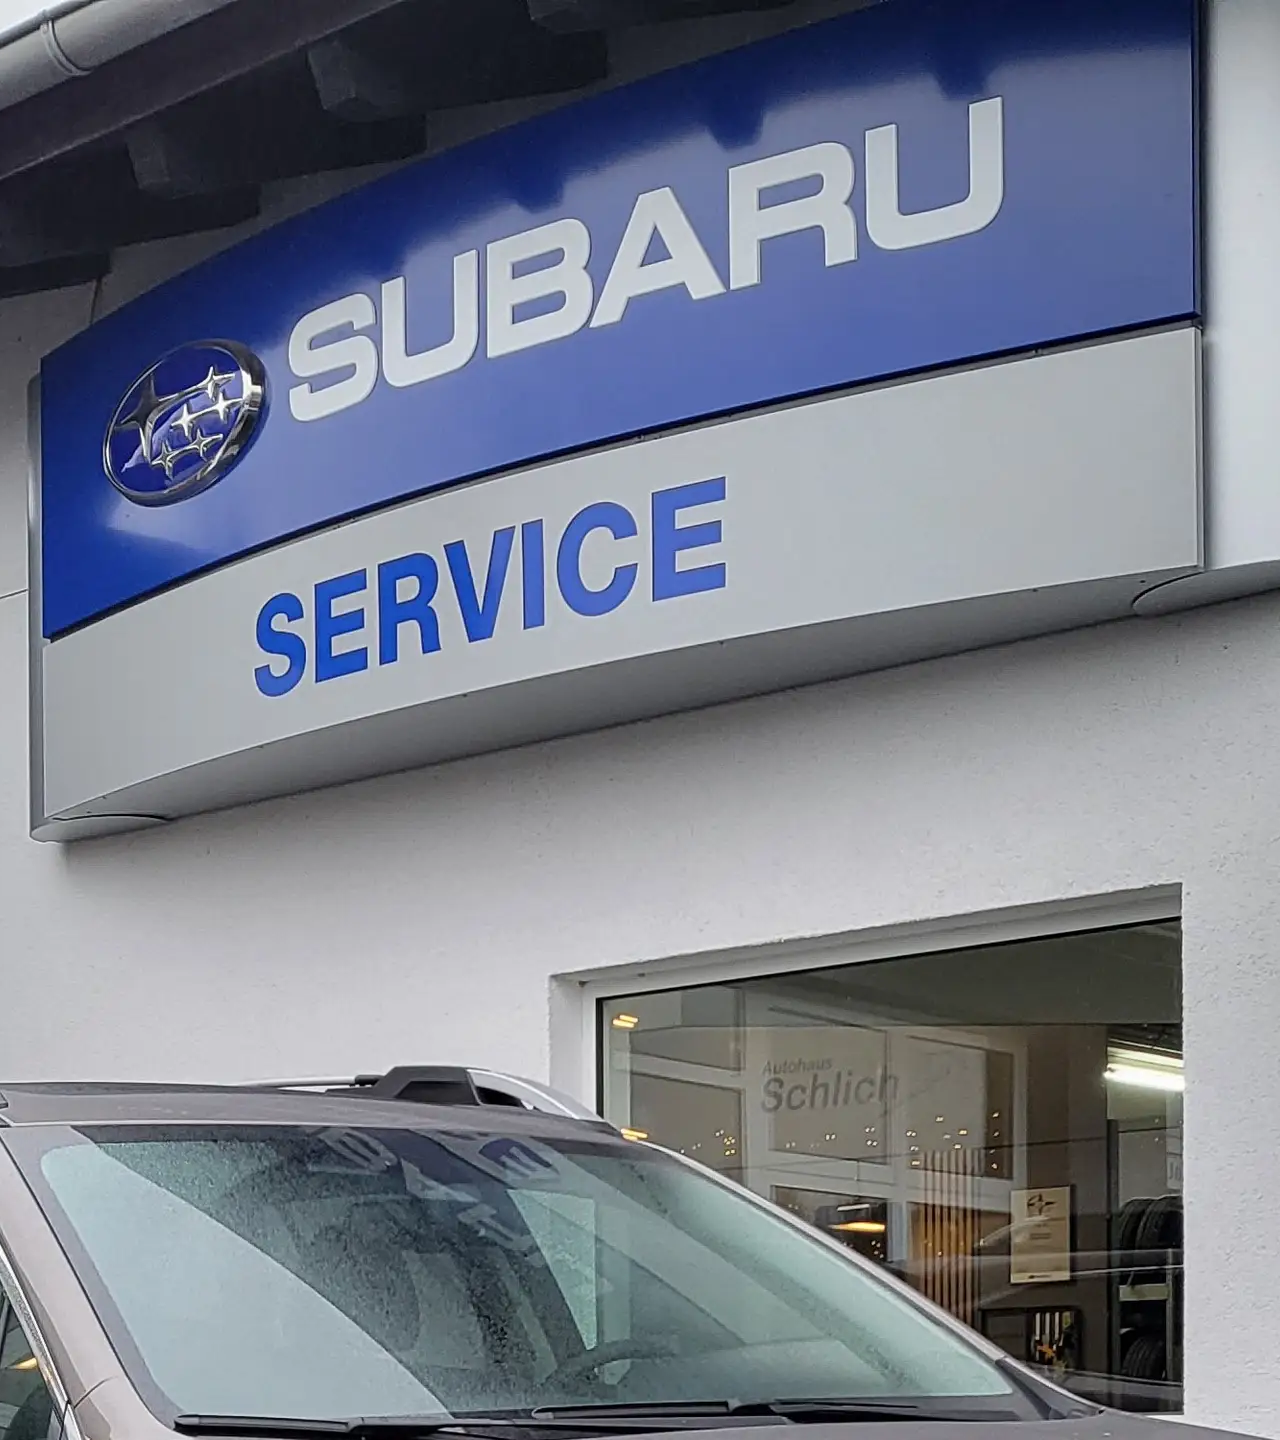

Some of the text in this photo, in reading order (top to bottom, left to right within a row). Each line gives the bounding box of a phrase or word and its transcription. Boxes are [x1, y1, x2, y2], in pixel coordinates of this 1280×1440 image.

[288, 95, 1004, 422] SUBARU
[253, 476, 727, 698] SERVICE
[760, 1065, 900, 1112] Schlich
[762, 1058, 833, 1075] Autohaus
